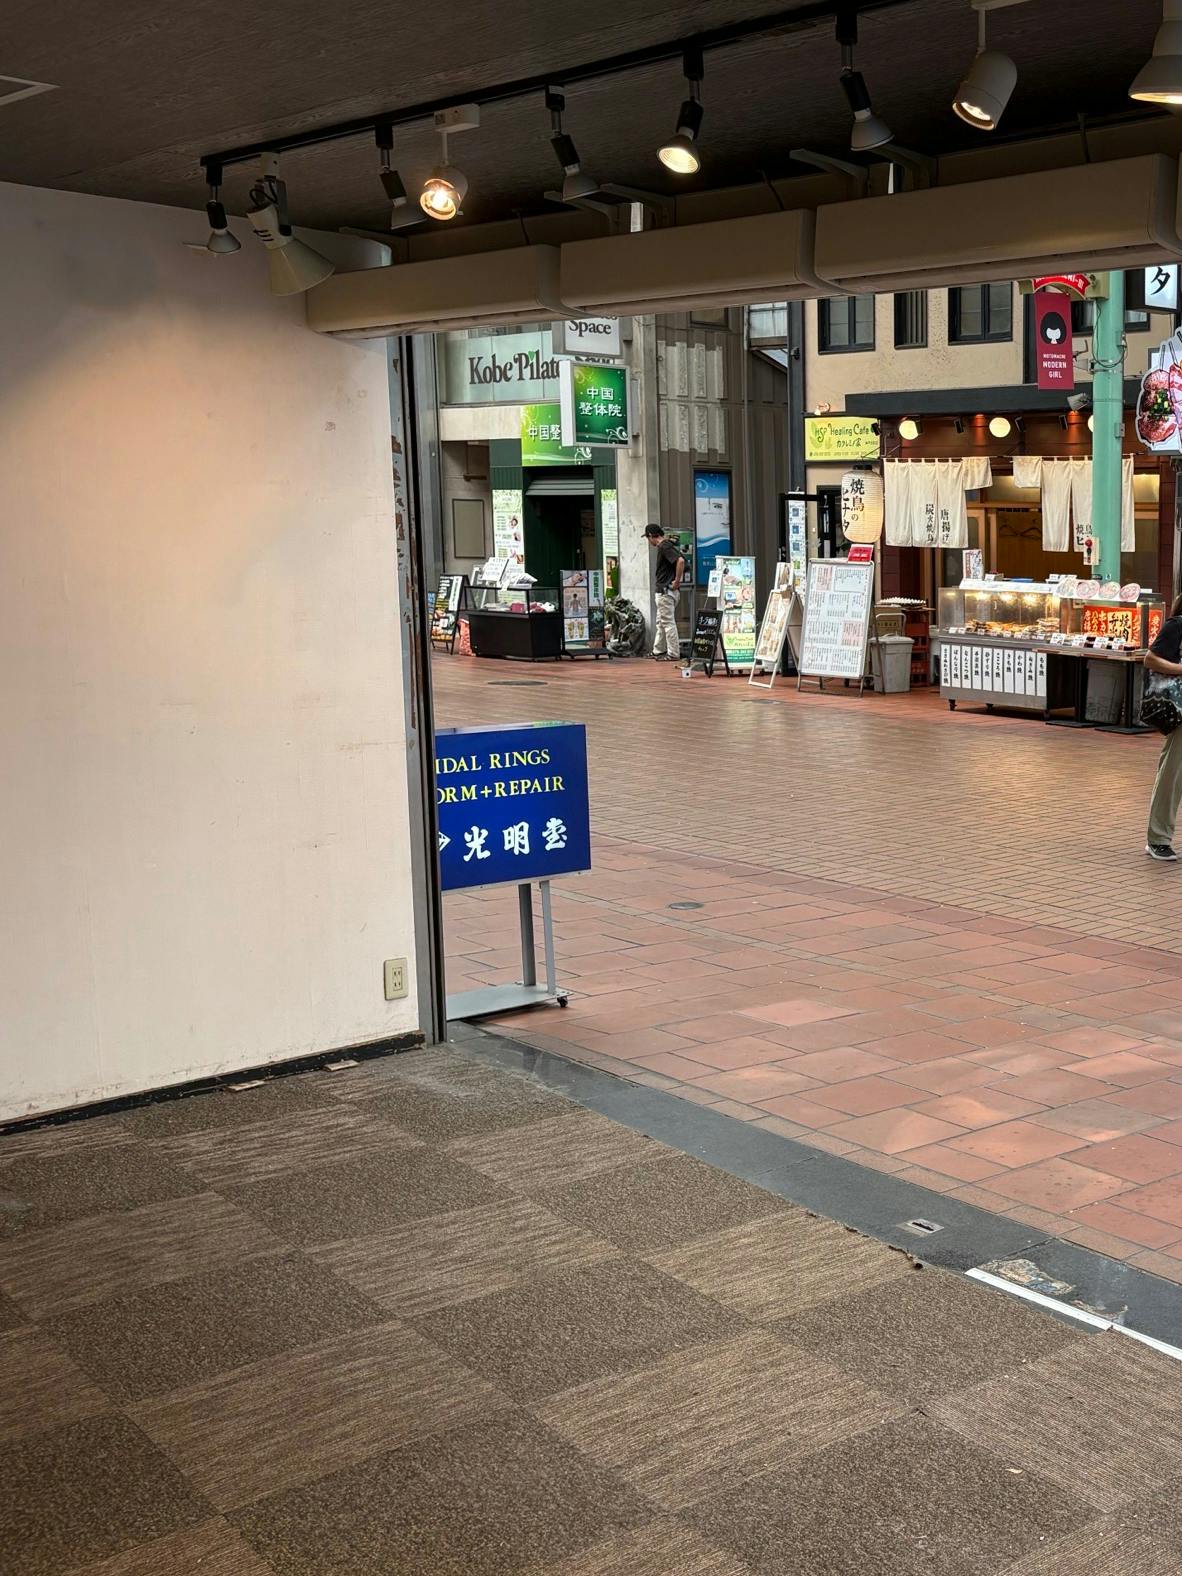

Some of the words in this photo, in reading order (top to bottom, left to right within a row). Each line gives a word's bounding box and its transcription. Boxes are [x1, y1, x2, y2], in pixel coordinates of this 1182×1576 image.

[568, 318, 611, 338] Space
[468, 354, 513, 385] Kobe
[1042, 361, 1067, 369] MODERN
[586, 386, 614, 401] 中国
[578, 402, 623, 417] 整体院
[849, 478, 865, 521] 焼鳥の
[489, 749, 551, 769] RINGS
[462, 817, 568, 862] 光明堂
